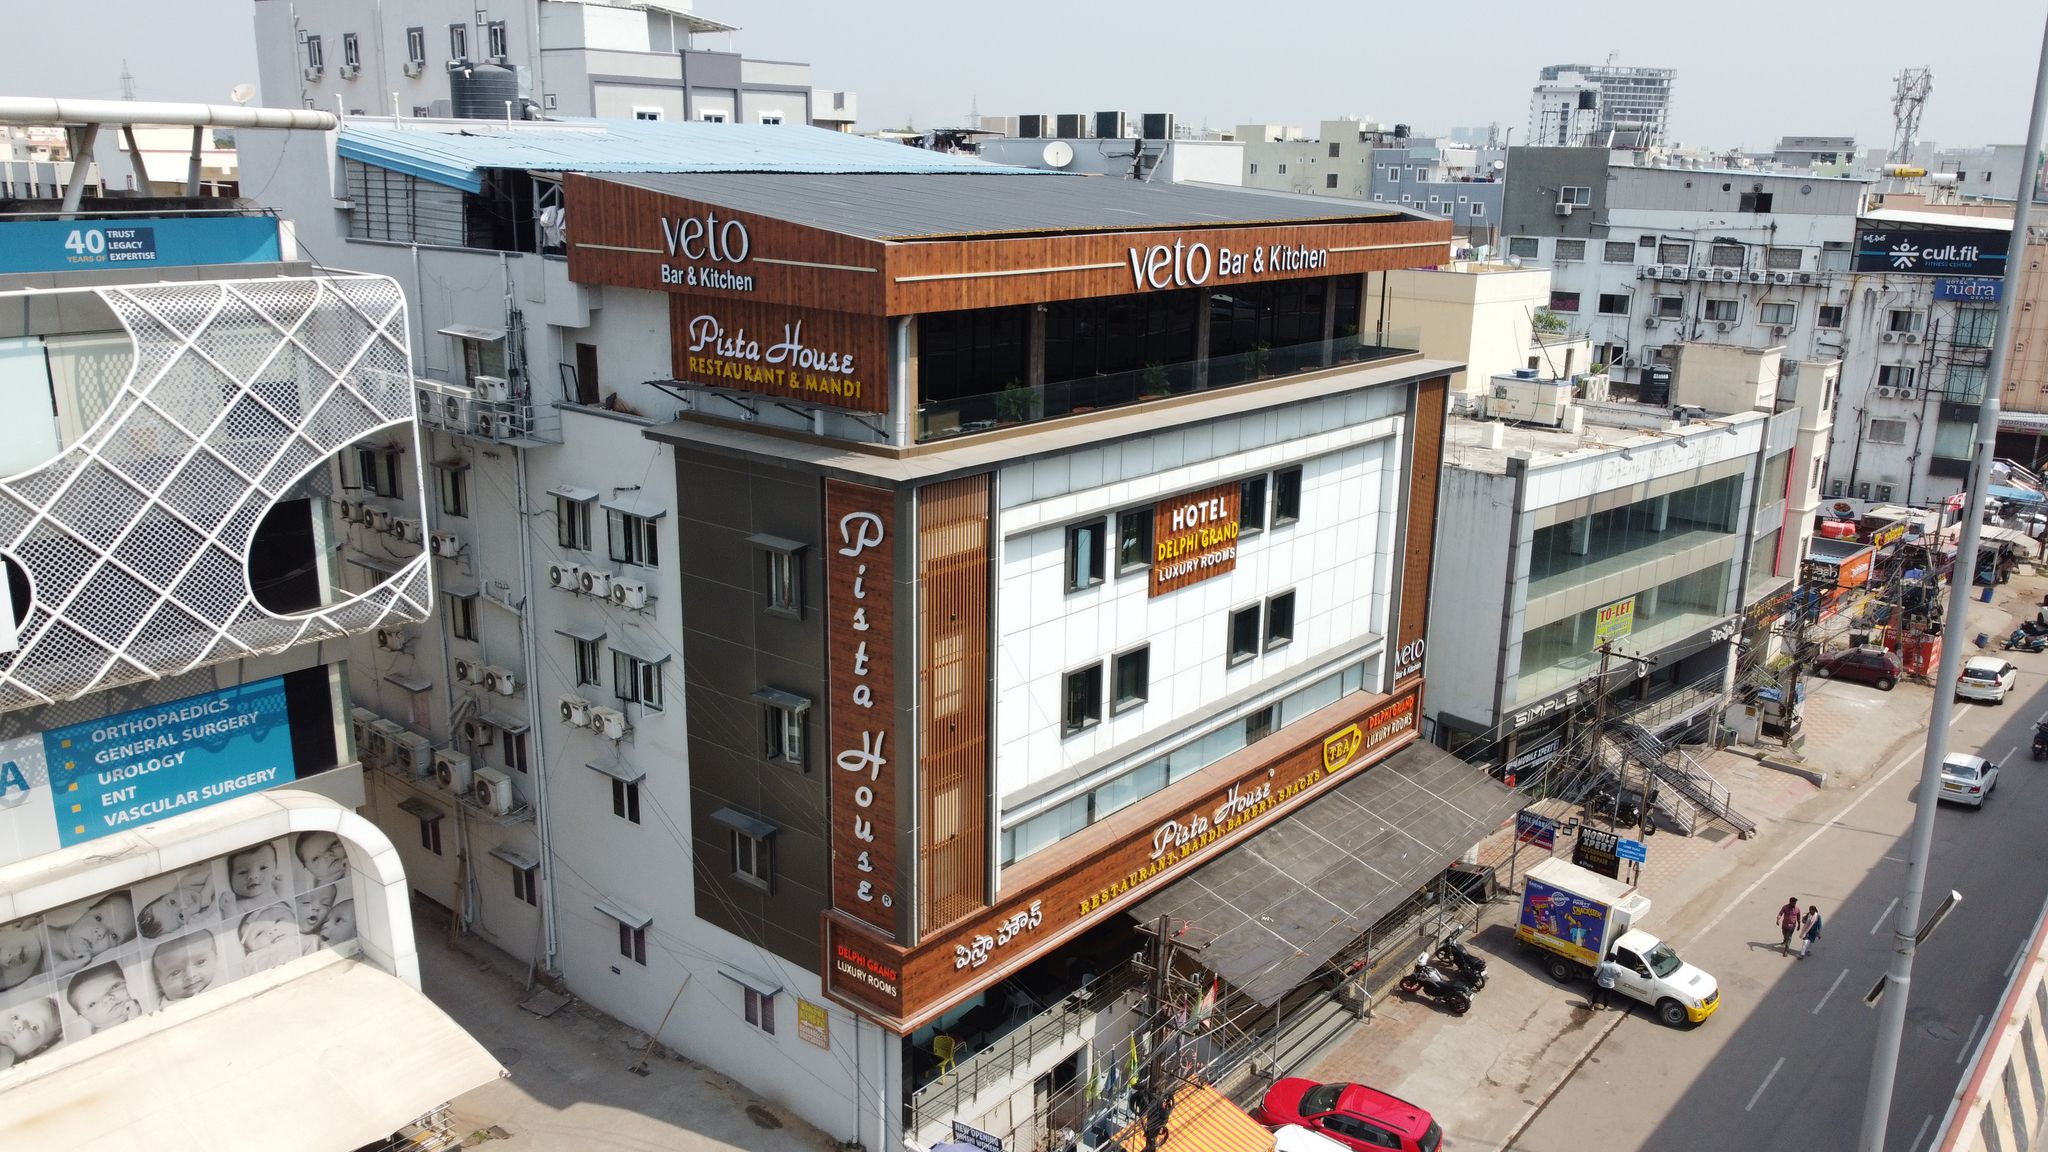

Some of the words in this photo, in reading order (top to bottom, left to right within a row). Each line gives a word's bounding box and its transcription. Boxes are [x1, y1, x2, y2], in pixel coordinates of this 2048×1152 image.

[64, 229, 105, 254] 40
[106, 230, 136, 239] TRUST
[108, 241, 143, 250] LEGACY
[661, 211, 749, 263] veto
[67, 255, 94, 263] YEARS
[96, 254, 106, 262] OF
[109, 251, 156, 261] EXPERTISE
[1130, 237, 1212, 290] veto
[1219, 248, 1249, 276] Bar
[1253, 246, 1265, 273] &
[1269, 244, 1328, 272] Kitchen
[1922, 245, 1979, 262] cult.fit
[661, 264, 684, 285] Bar
[687, 266, 697, 286] &
[700, 267, 753, 291] Kitchen
[1945, 281, 1995, 296] rudra
[688, 314, 761, 362] Pista
[765, 319, 855, 375] House
[689, 356, 785, 386] RESTAURANT
[789, 372, 801, 389] &
[805, 373, 861, 398] MANDI
[1172, 497, 1228, 531] HOTEL
[1158, 532, 1199, 561] DELPHI
[1201, 521, 1239, 548] GRAND
[1159, 558, 1199, 582] LUXURY
[1200, 547, 1236, 568] ROOMS
[1600, 600, 1632, 622] TO-LET
[91, 699, 230, 743] ORTHOPAEDICS
[1368, 708, 1393, 731] DELPHI
[1392, 695, 1415, 720] GRAND
[1514, 690, 1579, 728] SIMPLE
[95, 733, 178, 764] GENERAL
[182, 711, 259, 741] SURGERY
[1366, 723, 1392, 749] LUXURY
[1391, 712, 1413, 733] ROOMS
[1328, 738, 1350, 761] TEA
[97, 751, 187, 785] UROLOGY
[101, 786, 137, 807] ENT
[103, 789, 199, 827] VASCULAR
[202, 767, 278, 799] SURGERY
[1278, 769, 1321, 802] SNACKS
[1151, 813, 1209, 860] Pista
[1213, 780, 1271, 825] House
[1582, 829, 1617, 845] MOBILE
[1583, 838, 1613, 853] XPERT
[837, 945, 867, 967] DELPHI
[867, 957, 897, 982] GRAND
[956, 935, 993, 969] పిస్తా
[837, 960, 867, 982] LUXURY
[867, 974, 897, 997] ROOMS
[954, 1122, 970, 1135] NEW
[970, 1130, 999, 1147] OPENING
